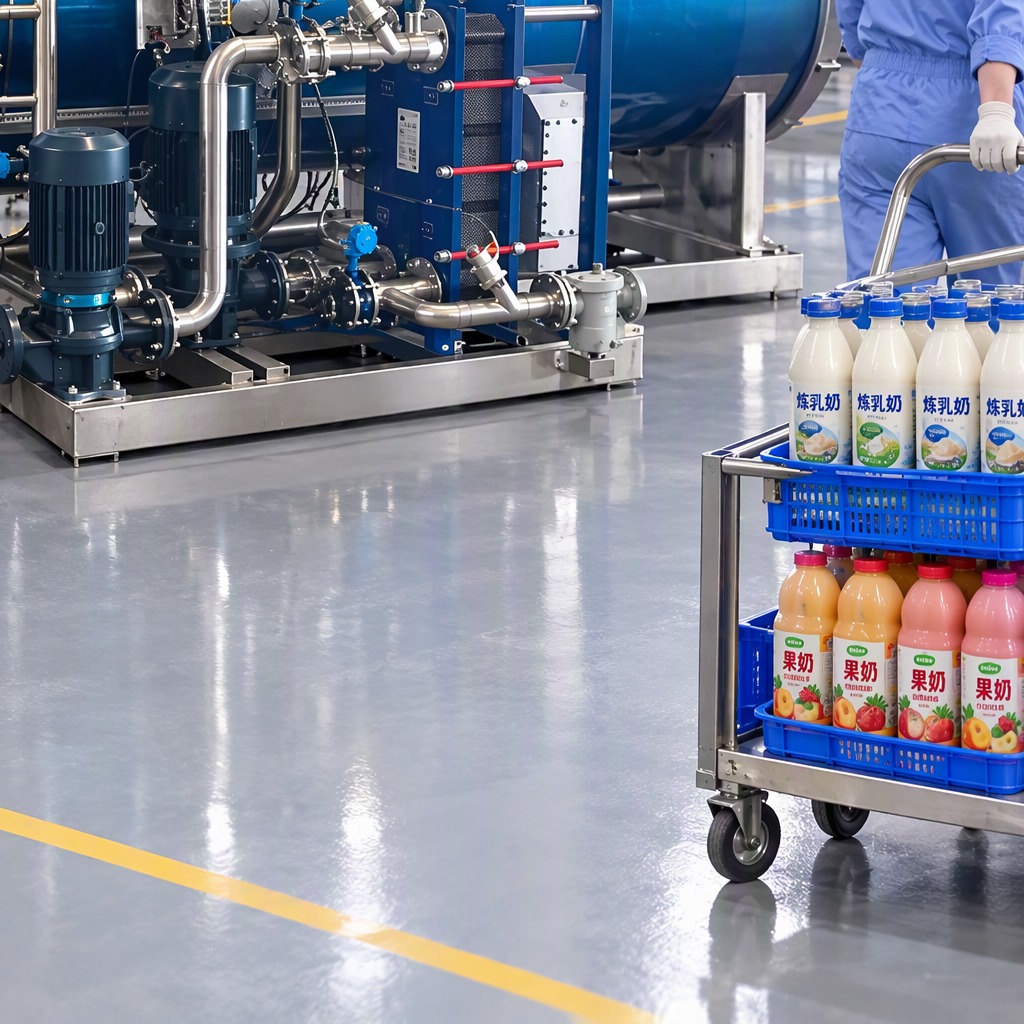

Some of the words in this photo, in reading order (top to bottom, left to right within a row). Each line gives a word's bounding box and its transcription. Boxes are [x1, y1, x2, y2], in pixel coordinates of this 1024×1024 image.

[796, 392, 840, 412] 炼乳奶
[857, 393, 902, 413] 炼乳奶
[923, 395, 970, 416] 炼乳奶
[783, 650, 814, 673] 果奶
[844, 659, 878, 683] 果奶
[911, 669, 946, 693] 果奶
[975, 677, 1012, 702] 果奶
